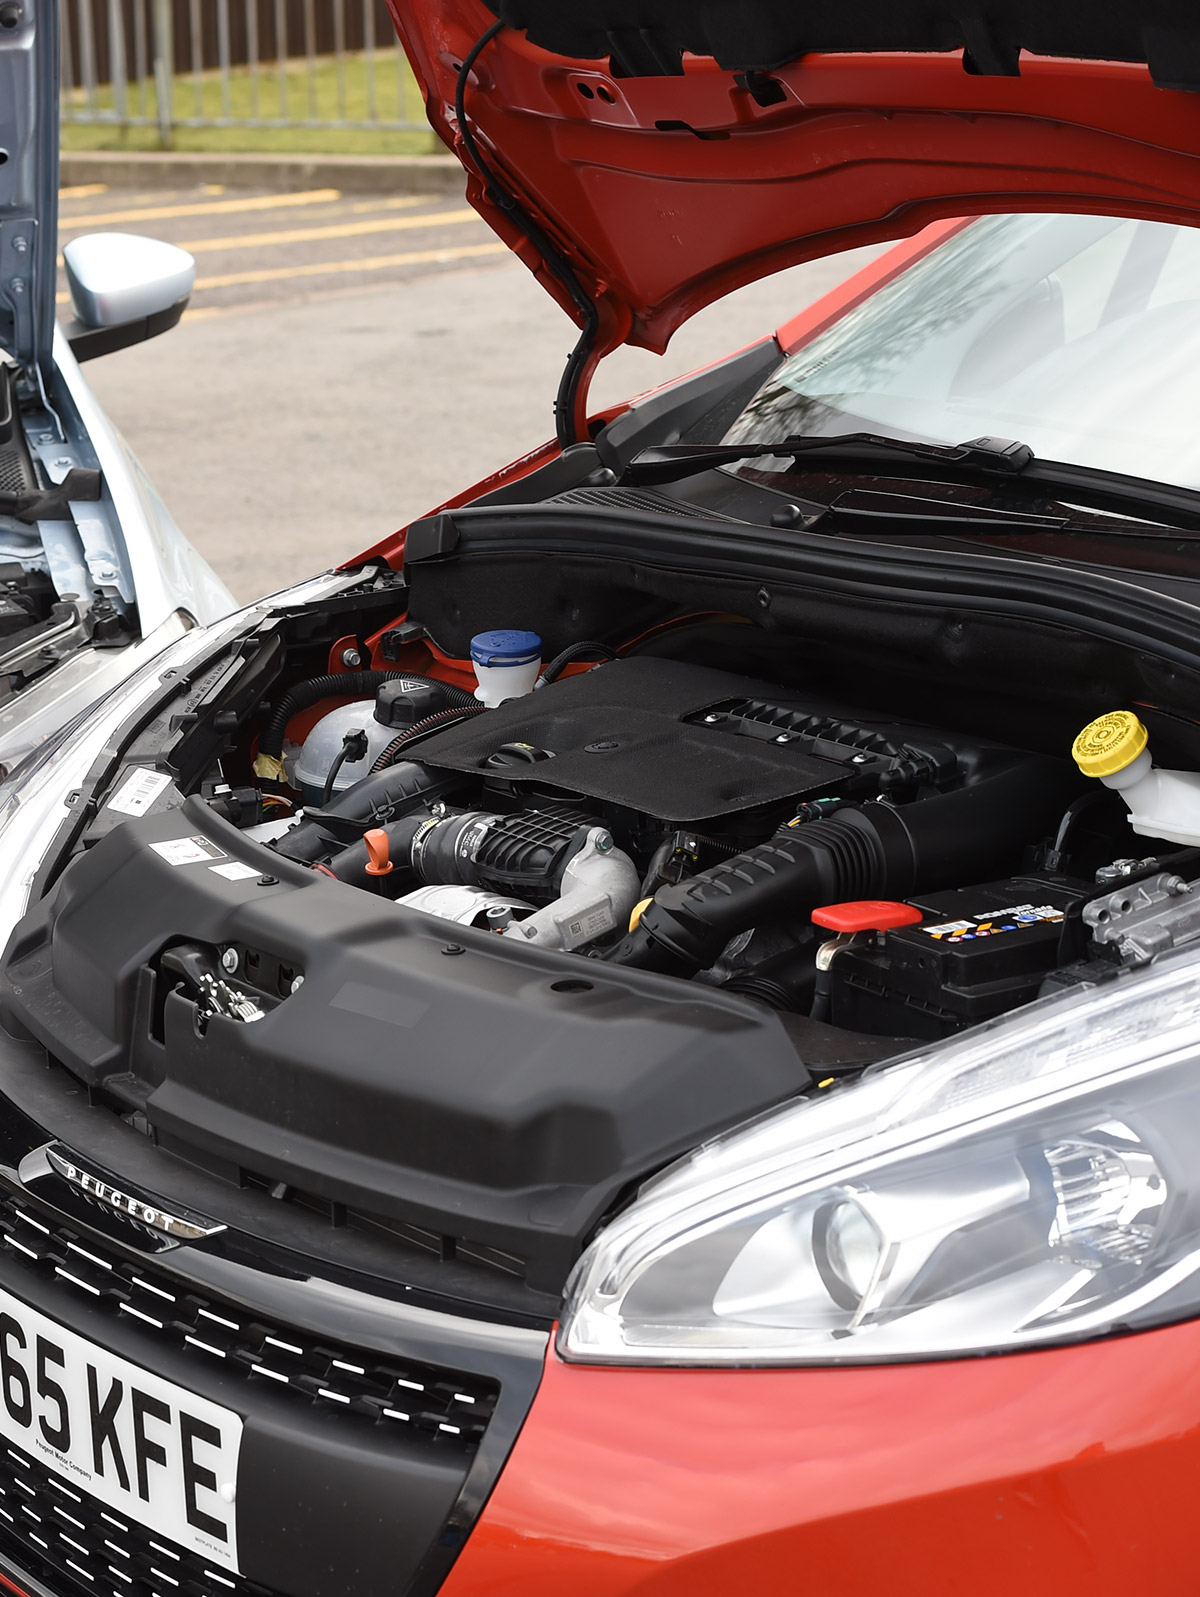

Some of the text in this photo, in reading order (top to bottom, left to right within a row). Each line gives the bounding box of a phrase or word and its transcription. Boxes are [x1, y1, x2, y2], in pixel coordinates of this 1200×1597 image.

[67, 1165, 174, 1232] PEUGEOT
[35, 1438, 54, 1456] Peugeot
[55, 1451, 69, 1465] Motor
[69, 1460, 92, 1481] Company
[86, 1362, 228, 1543] KFE
